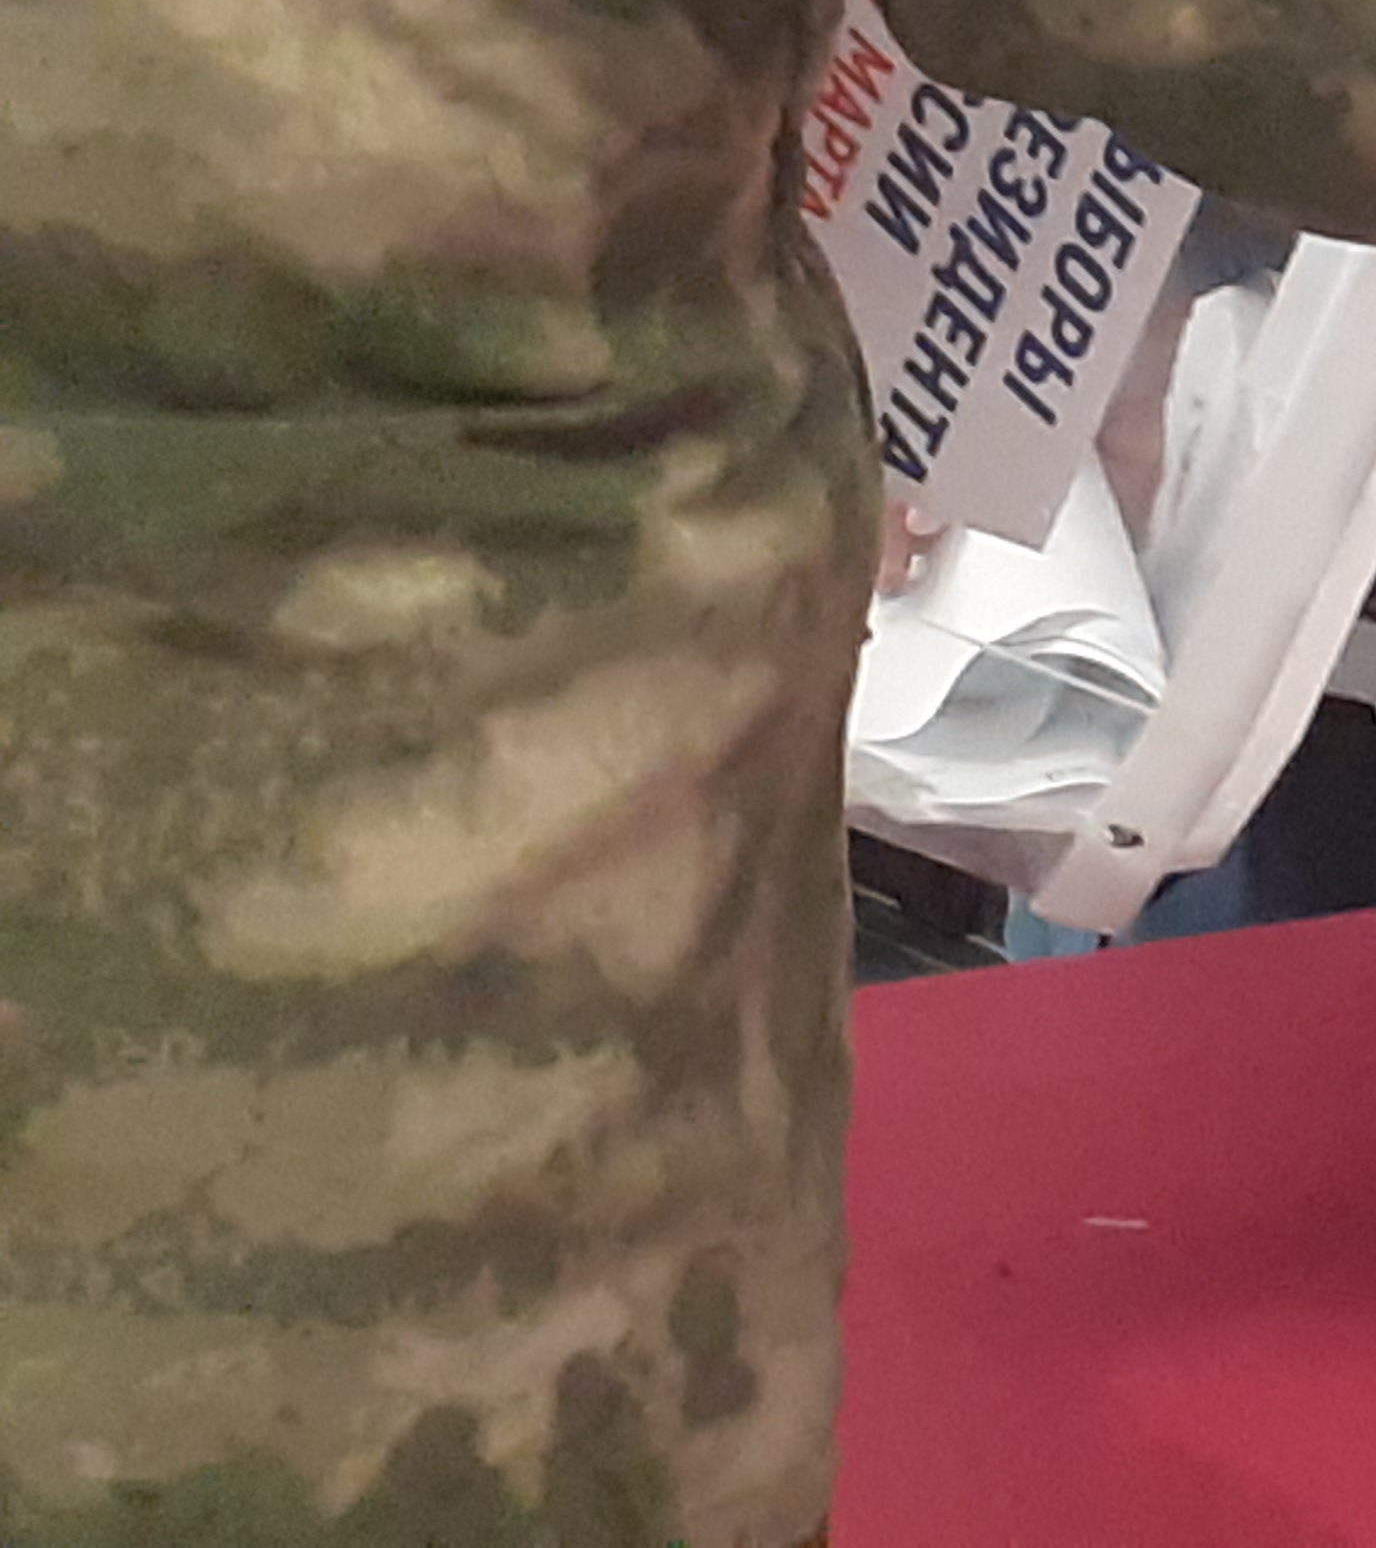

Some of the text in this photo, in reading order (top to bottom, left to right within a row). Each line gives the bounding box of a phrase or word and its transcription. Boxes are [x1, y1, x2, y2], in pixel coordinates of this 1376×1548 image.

[863, 82, 984, 255] СИИ
[880, 104, 1082, 485] ЕЗИДЕНТА
[1002, 130, 1163, 427] ЫБОРЫ
